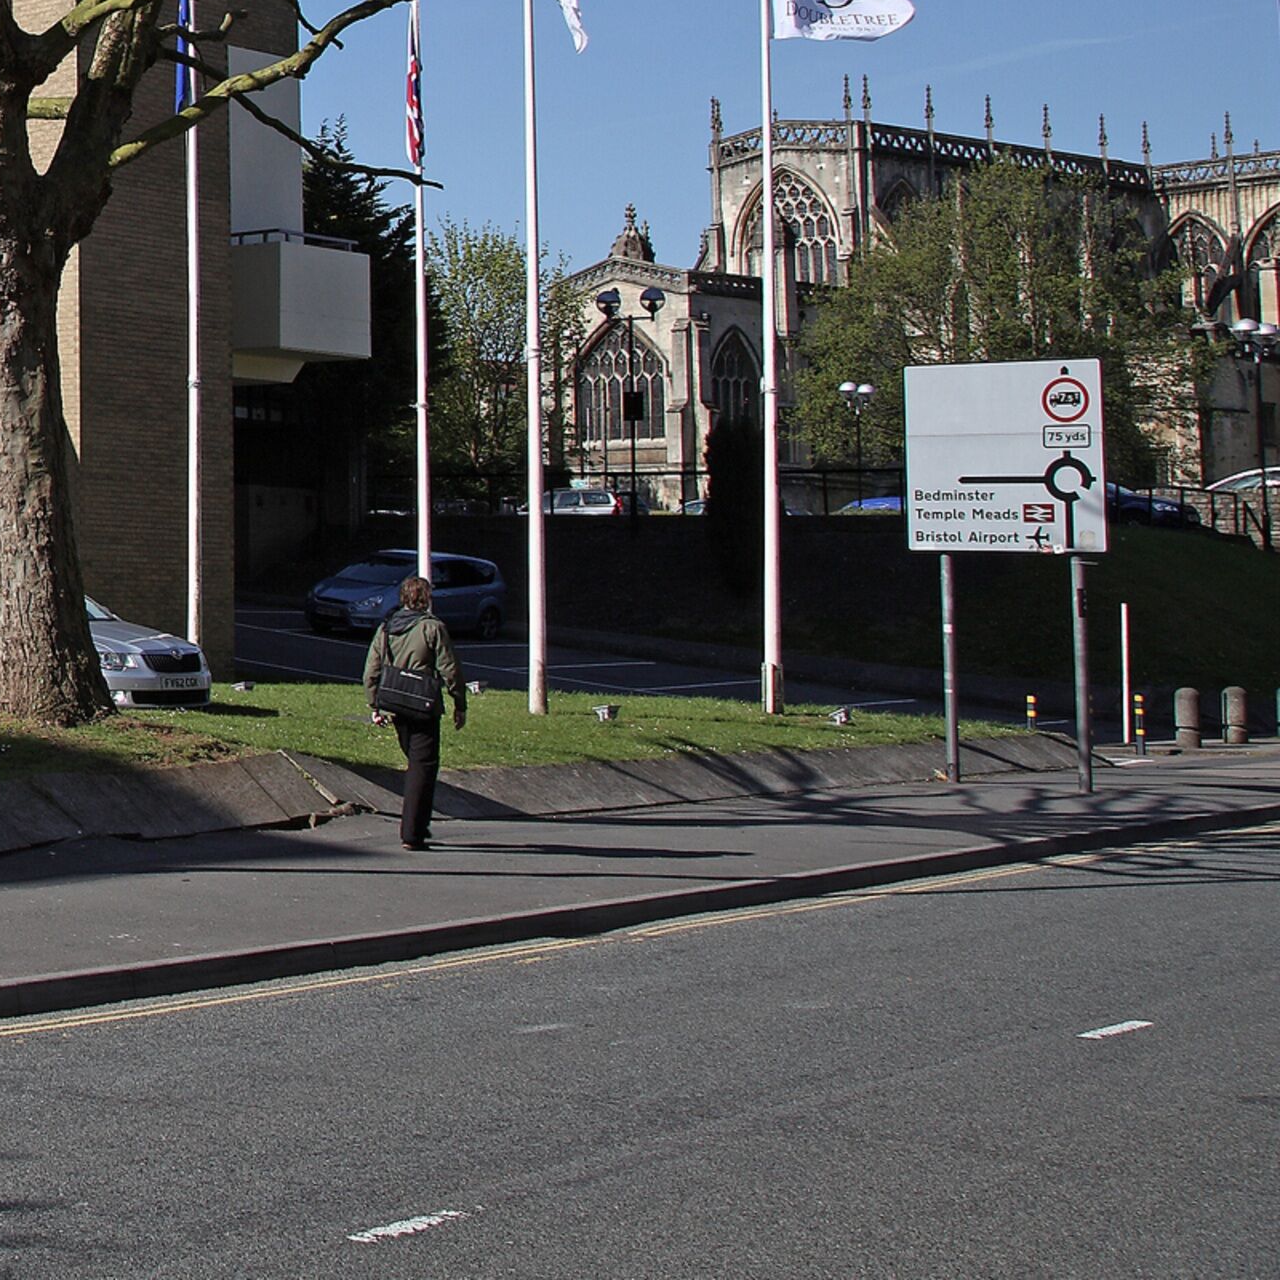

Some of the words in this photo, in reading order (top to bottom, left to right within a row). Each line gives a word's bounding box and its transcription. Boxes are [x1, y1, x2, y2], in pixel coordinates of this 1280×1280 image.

[1048, 432, 1063, 441] 75
[1065, 431, 1086, 444] yds
[915, 490, 995, 501] Bedminster
[916, 509, 965, 521] Temple
[973, 509, 1019, 520] Meads
[916, 531, 962, 542] Bristol
[969, 531, 1020, 544] Airport
